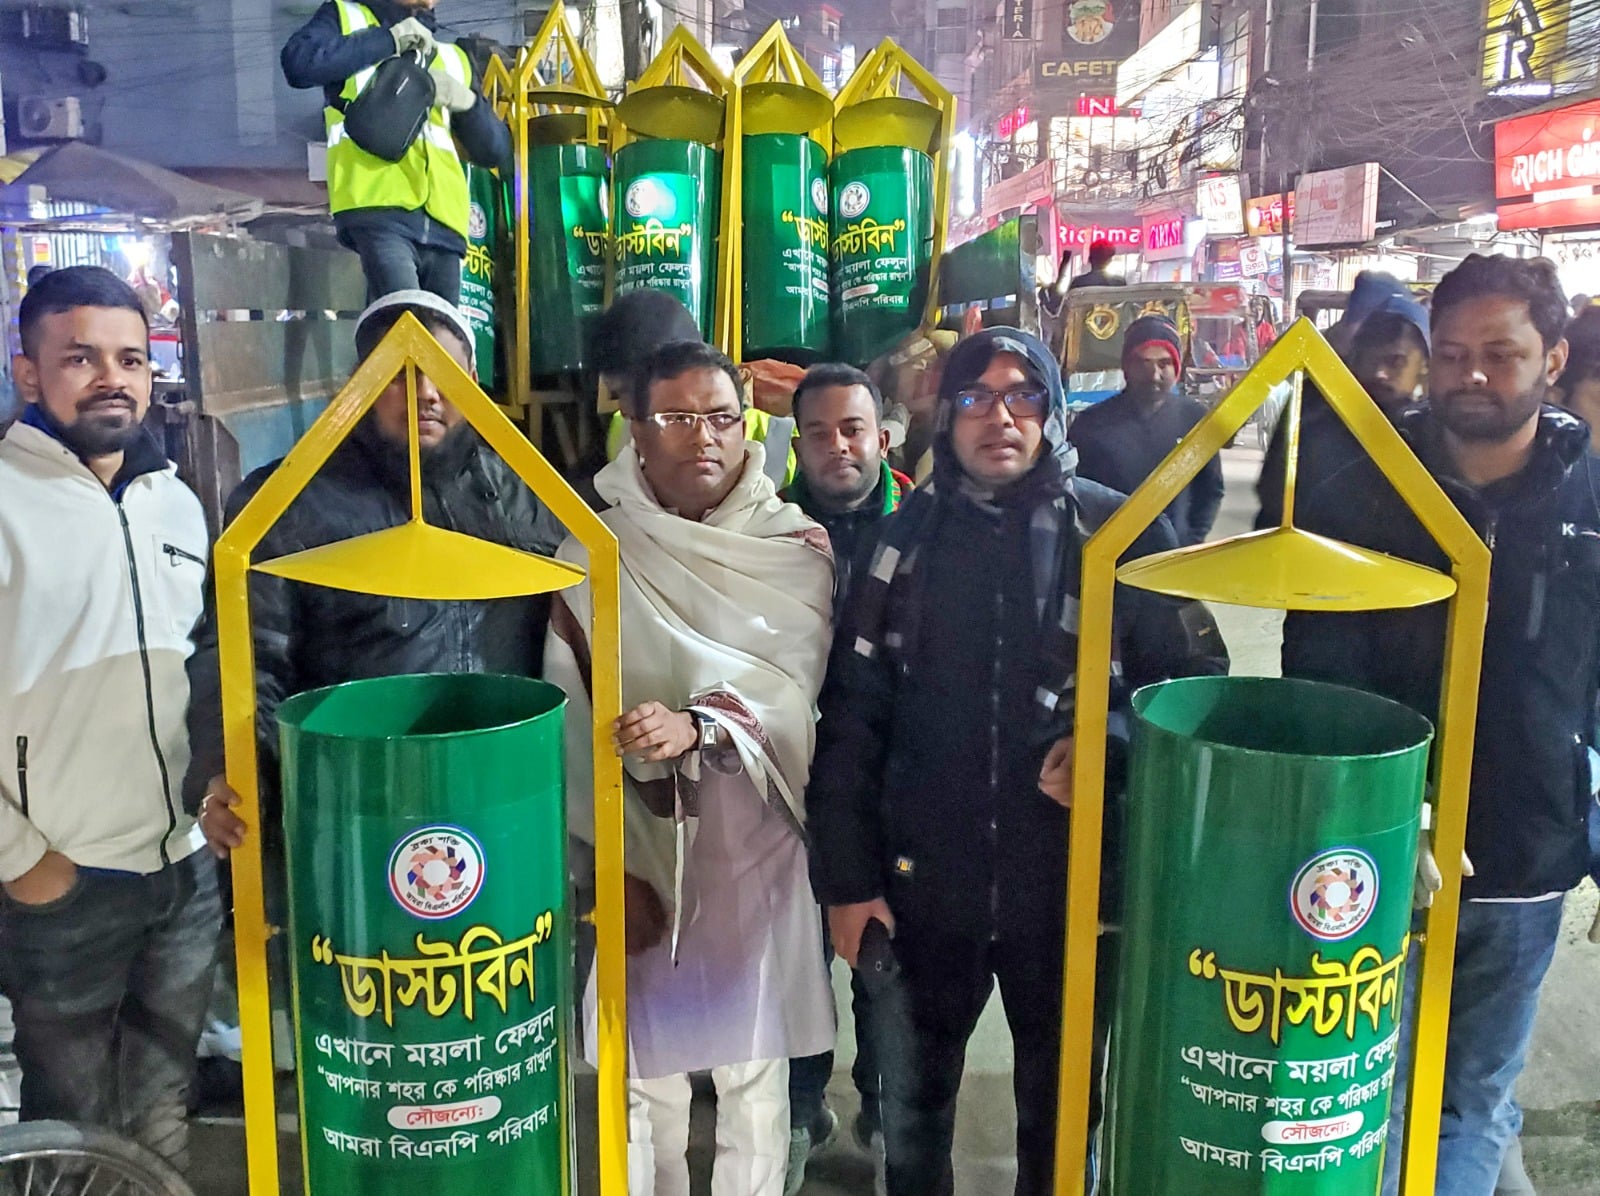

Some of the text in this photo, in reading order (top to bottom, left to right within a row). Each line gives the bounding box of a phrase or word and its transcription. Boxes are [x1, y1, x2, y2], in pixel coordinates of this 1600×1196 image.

[1041, 61, 1126, 76] CAFET
[1512, 148, 1563, 191] RICH
[1562, 522, 1575, 536] K
[315, 1005, 556, 1068] এখানে ময়লা ফেলুন
[1180, 1045, 1279, 1083] এখানে
[1284, 1051, 1361, 1085] ময়লা
[386, 1079, 427, 1104] শহর
[433, 1079, 459, 1100] কে
[1264, 1096, 1306, 1119] শহর
[1310, 1096, 1334, 1116] কে
[322, 1126, 383, 1159] আমরা
[388, 1130, 480, 1160] বিএনপি
[1179, 1136, 1253, 1171] আমরা
[1258, 1147, 1346, 1174] বিএনপি
